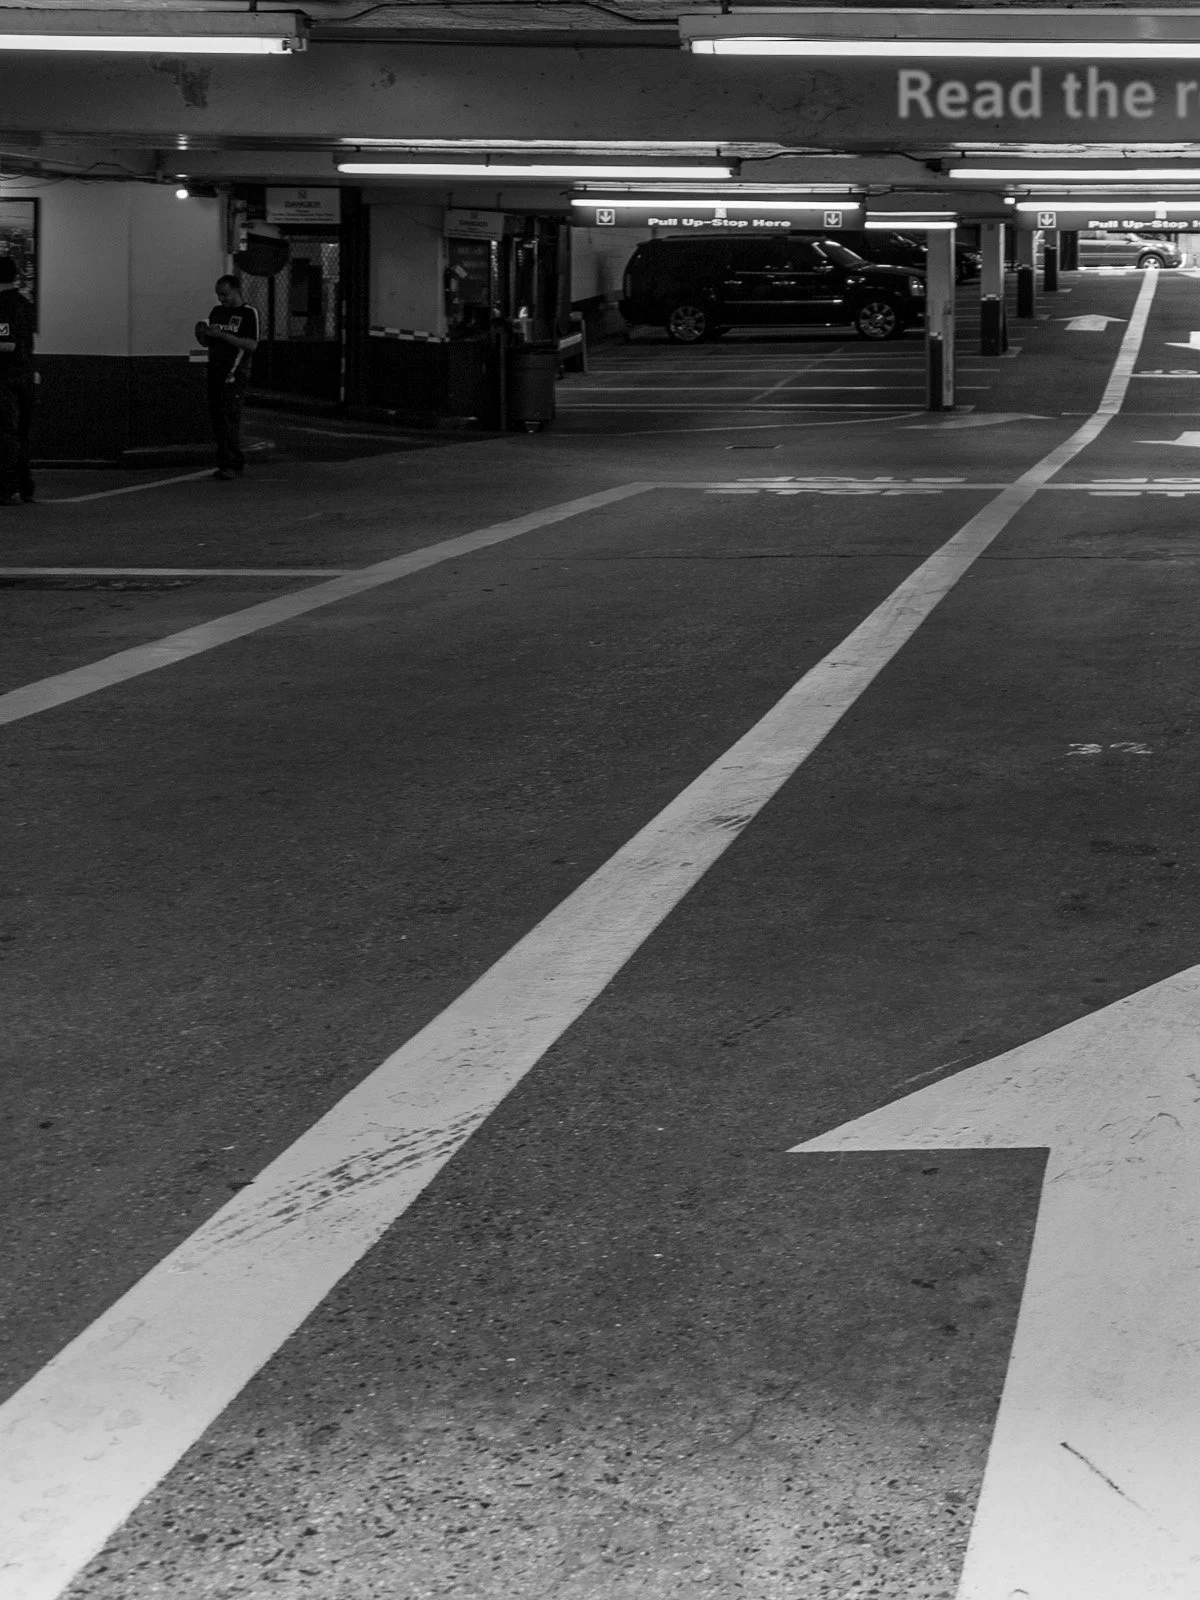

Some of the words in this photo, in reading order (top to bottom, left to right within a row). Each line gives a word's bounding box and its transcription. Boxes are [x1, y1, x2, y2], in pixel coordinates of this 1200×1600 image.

[648, 217, 677, 227] Pull
[682, 218, 748, 228] Up-Stop
[752, 218, 791, 228] Here
[1088, 220, 1118, 228] Pull
[1122, 220, 1188, 229] Up-Stop
